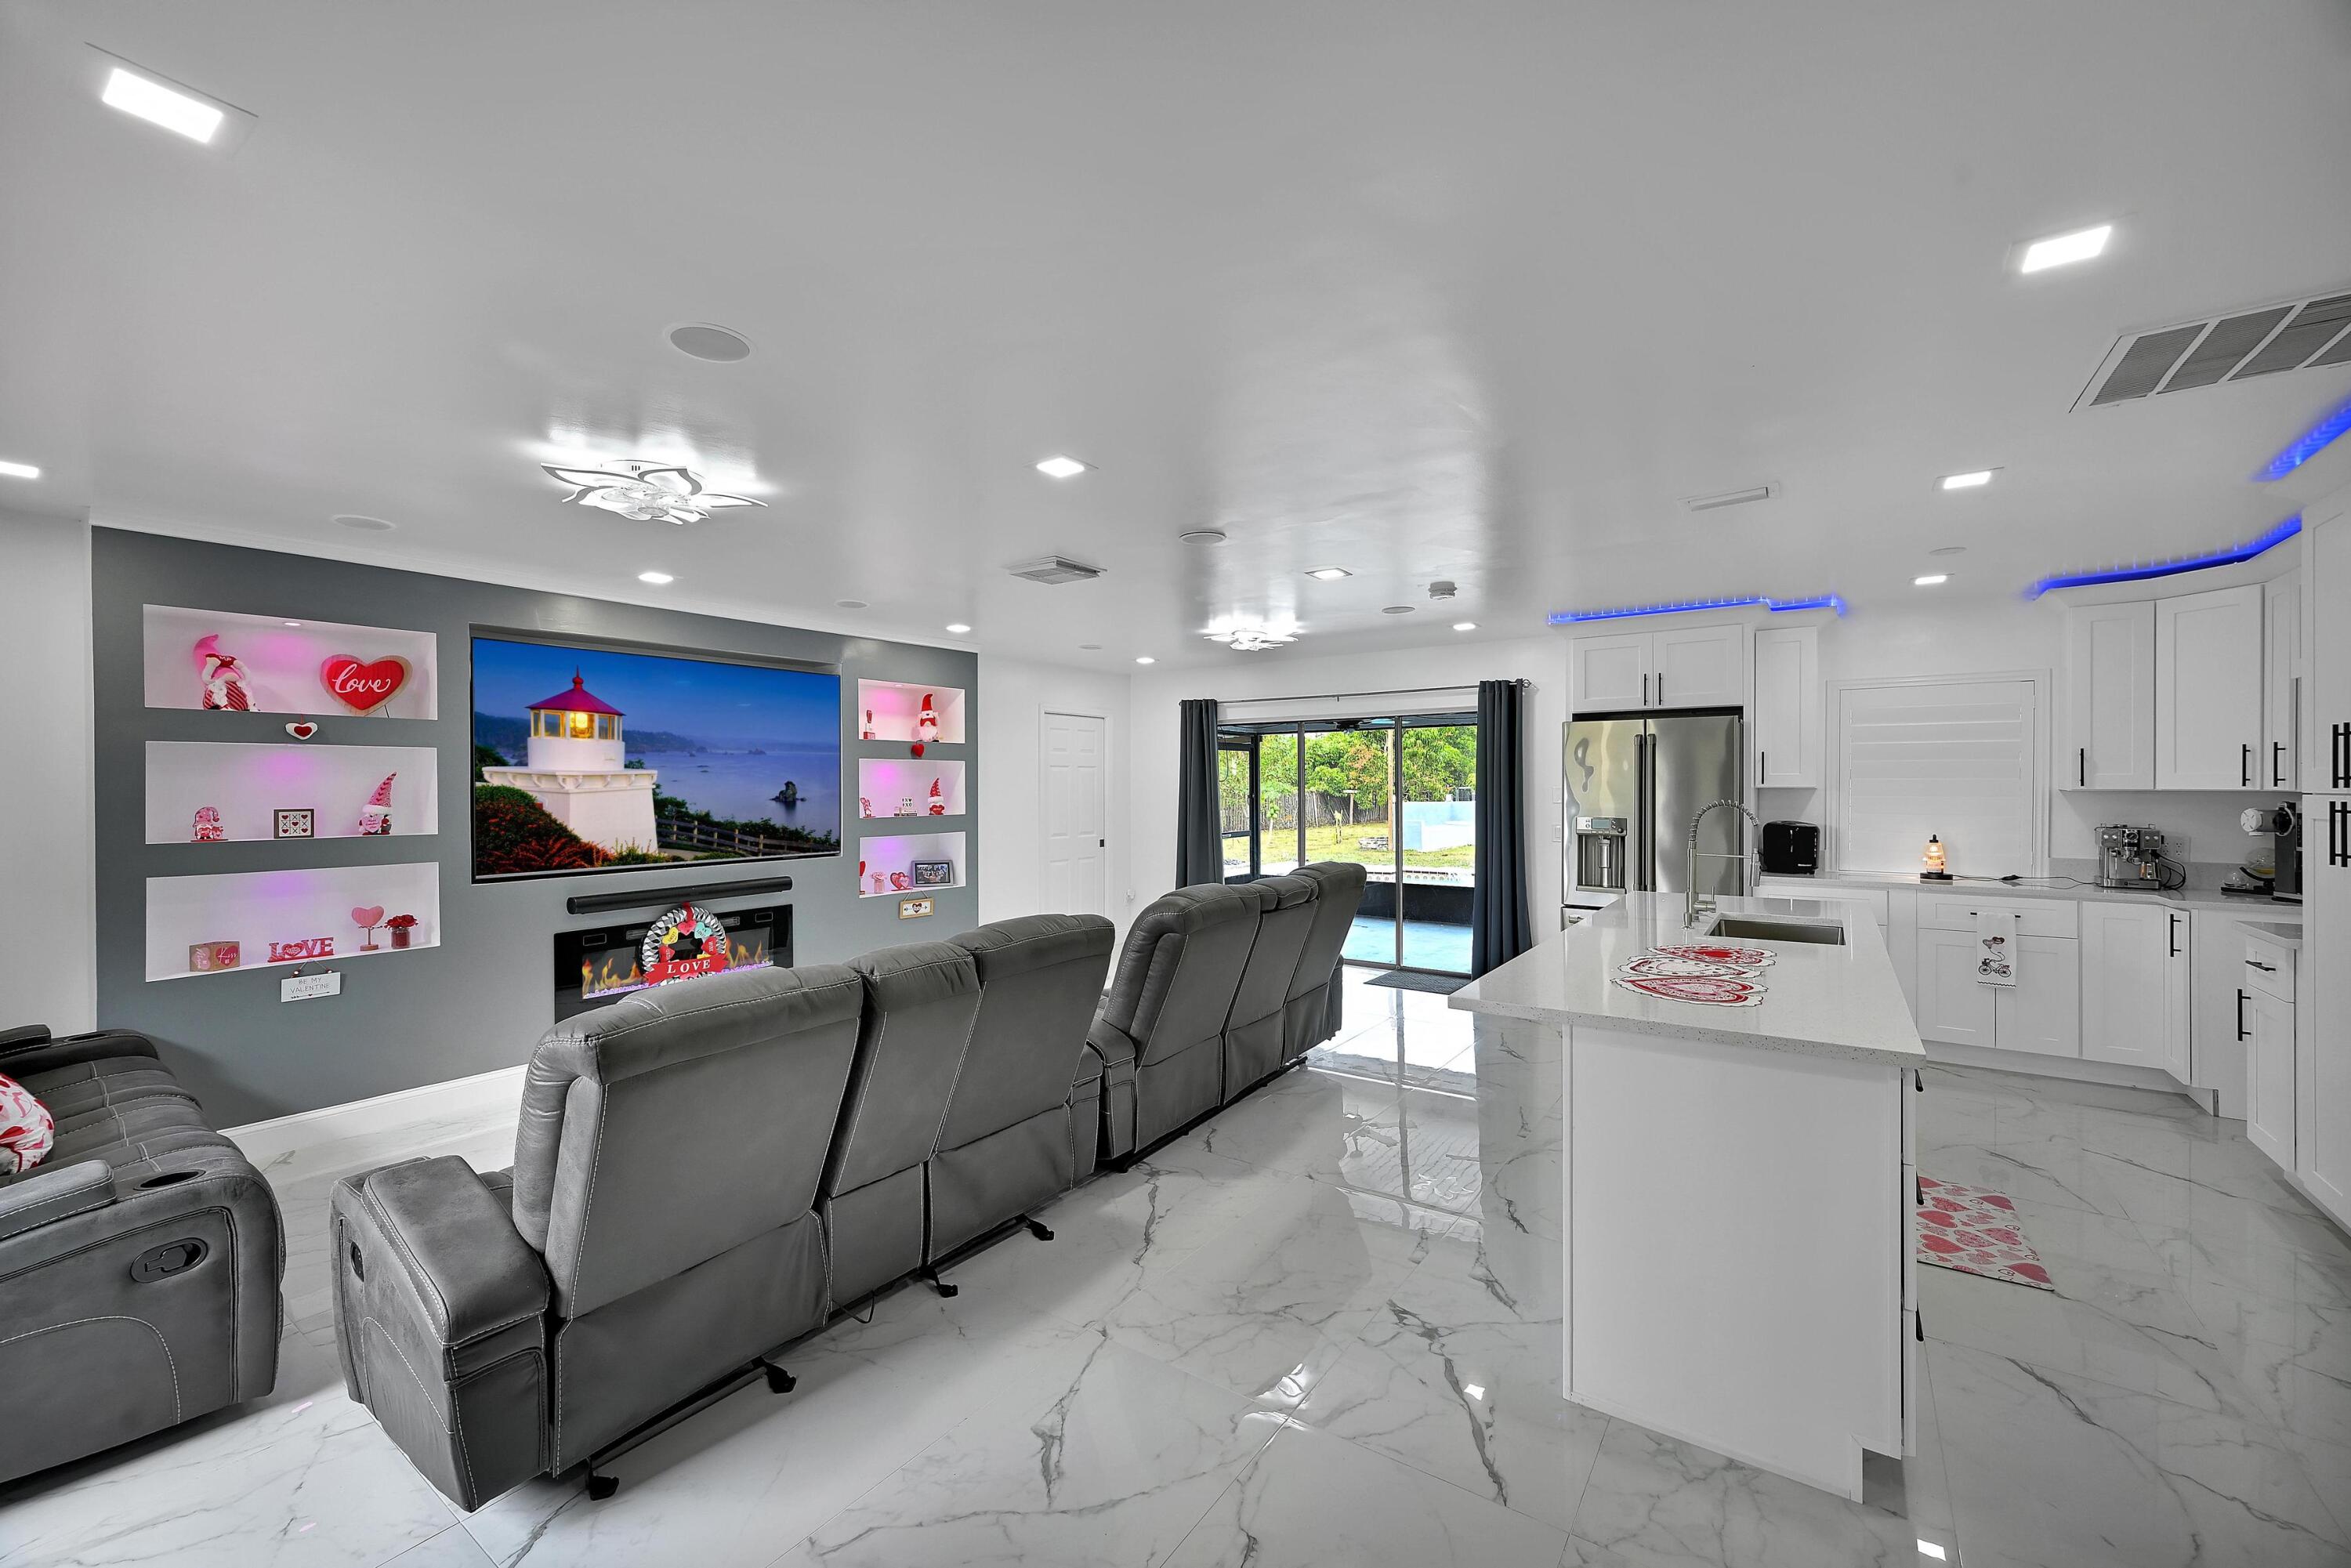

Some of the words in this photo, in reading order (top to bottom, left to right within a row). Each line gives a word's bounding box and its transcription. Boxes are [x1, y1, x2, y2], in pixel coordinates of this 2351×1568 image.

[332, 664, 391, 693] love
[667, 959, 711, 974] LOVE
[290, 983, 330, 994] VALENTINE
